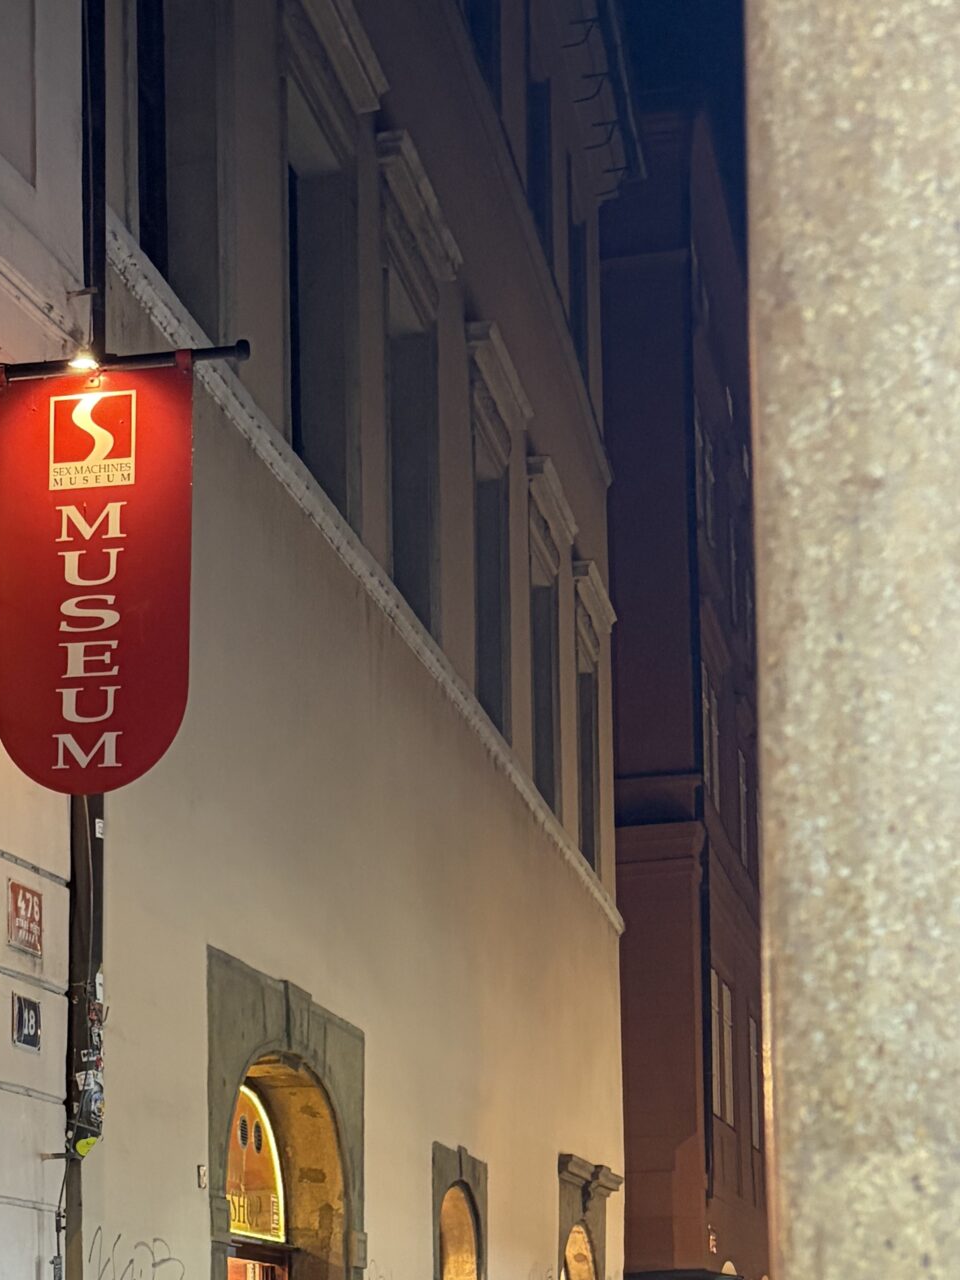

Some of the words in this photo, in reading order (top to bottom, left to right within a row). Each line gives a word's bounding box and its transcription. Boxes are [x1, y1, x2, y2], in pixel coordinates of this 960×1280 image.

[53, 466, 72, 477] SEX
[74, 462, 131, 475] MACHINES
[53, 473, 131, 487] MUSEUM
[52, 501, 127, 769] MUSEUM
[23, 1008, 36, 1036] 18
